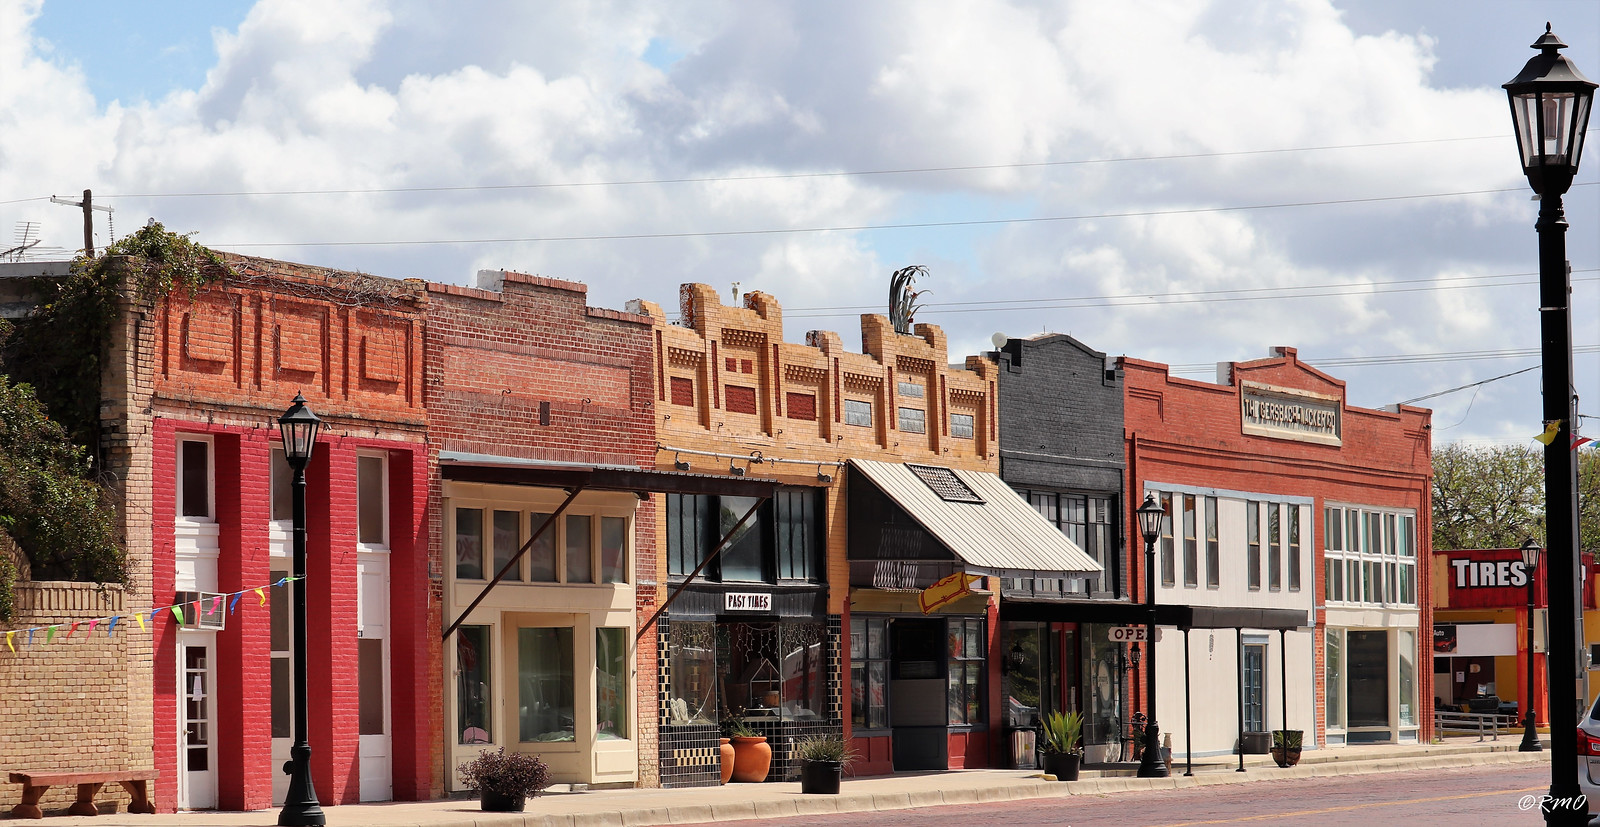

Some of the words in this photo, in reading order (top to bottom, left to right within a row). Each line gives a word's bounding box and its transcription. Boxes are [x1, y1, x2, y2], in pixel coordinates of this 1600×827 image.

[1452, 559, 1527, 588] TIRES
[729, 594, 746, 608] PAST
[1114, 628, 1148, 640] OPE
